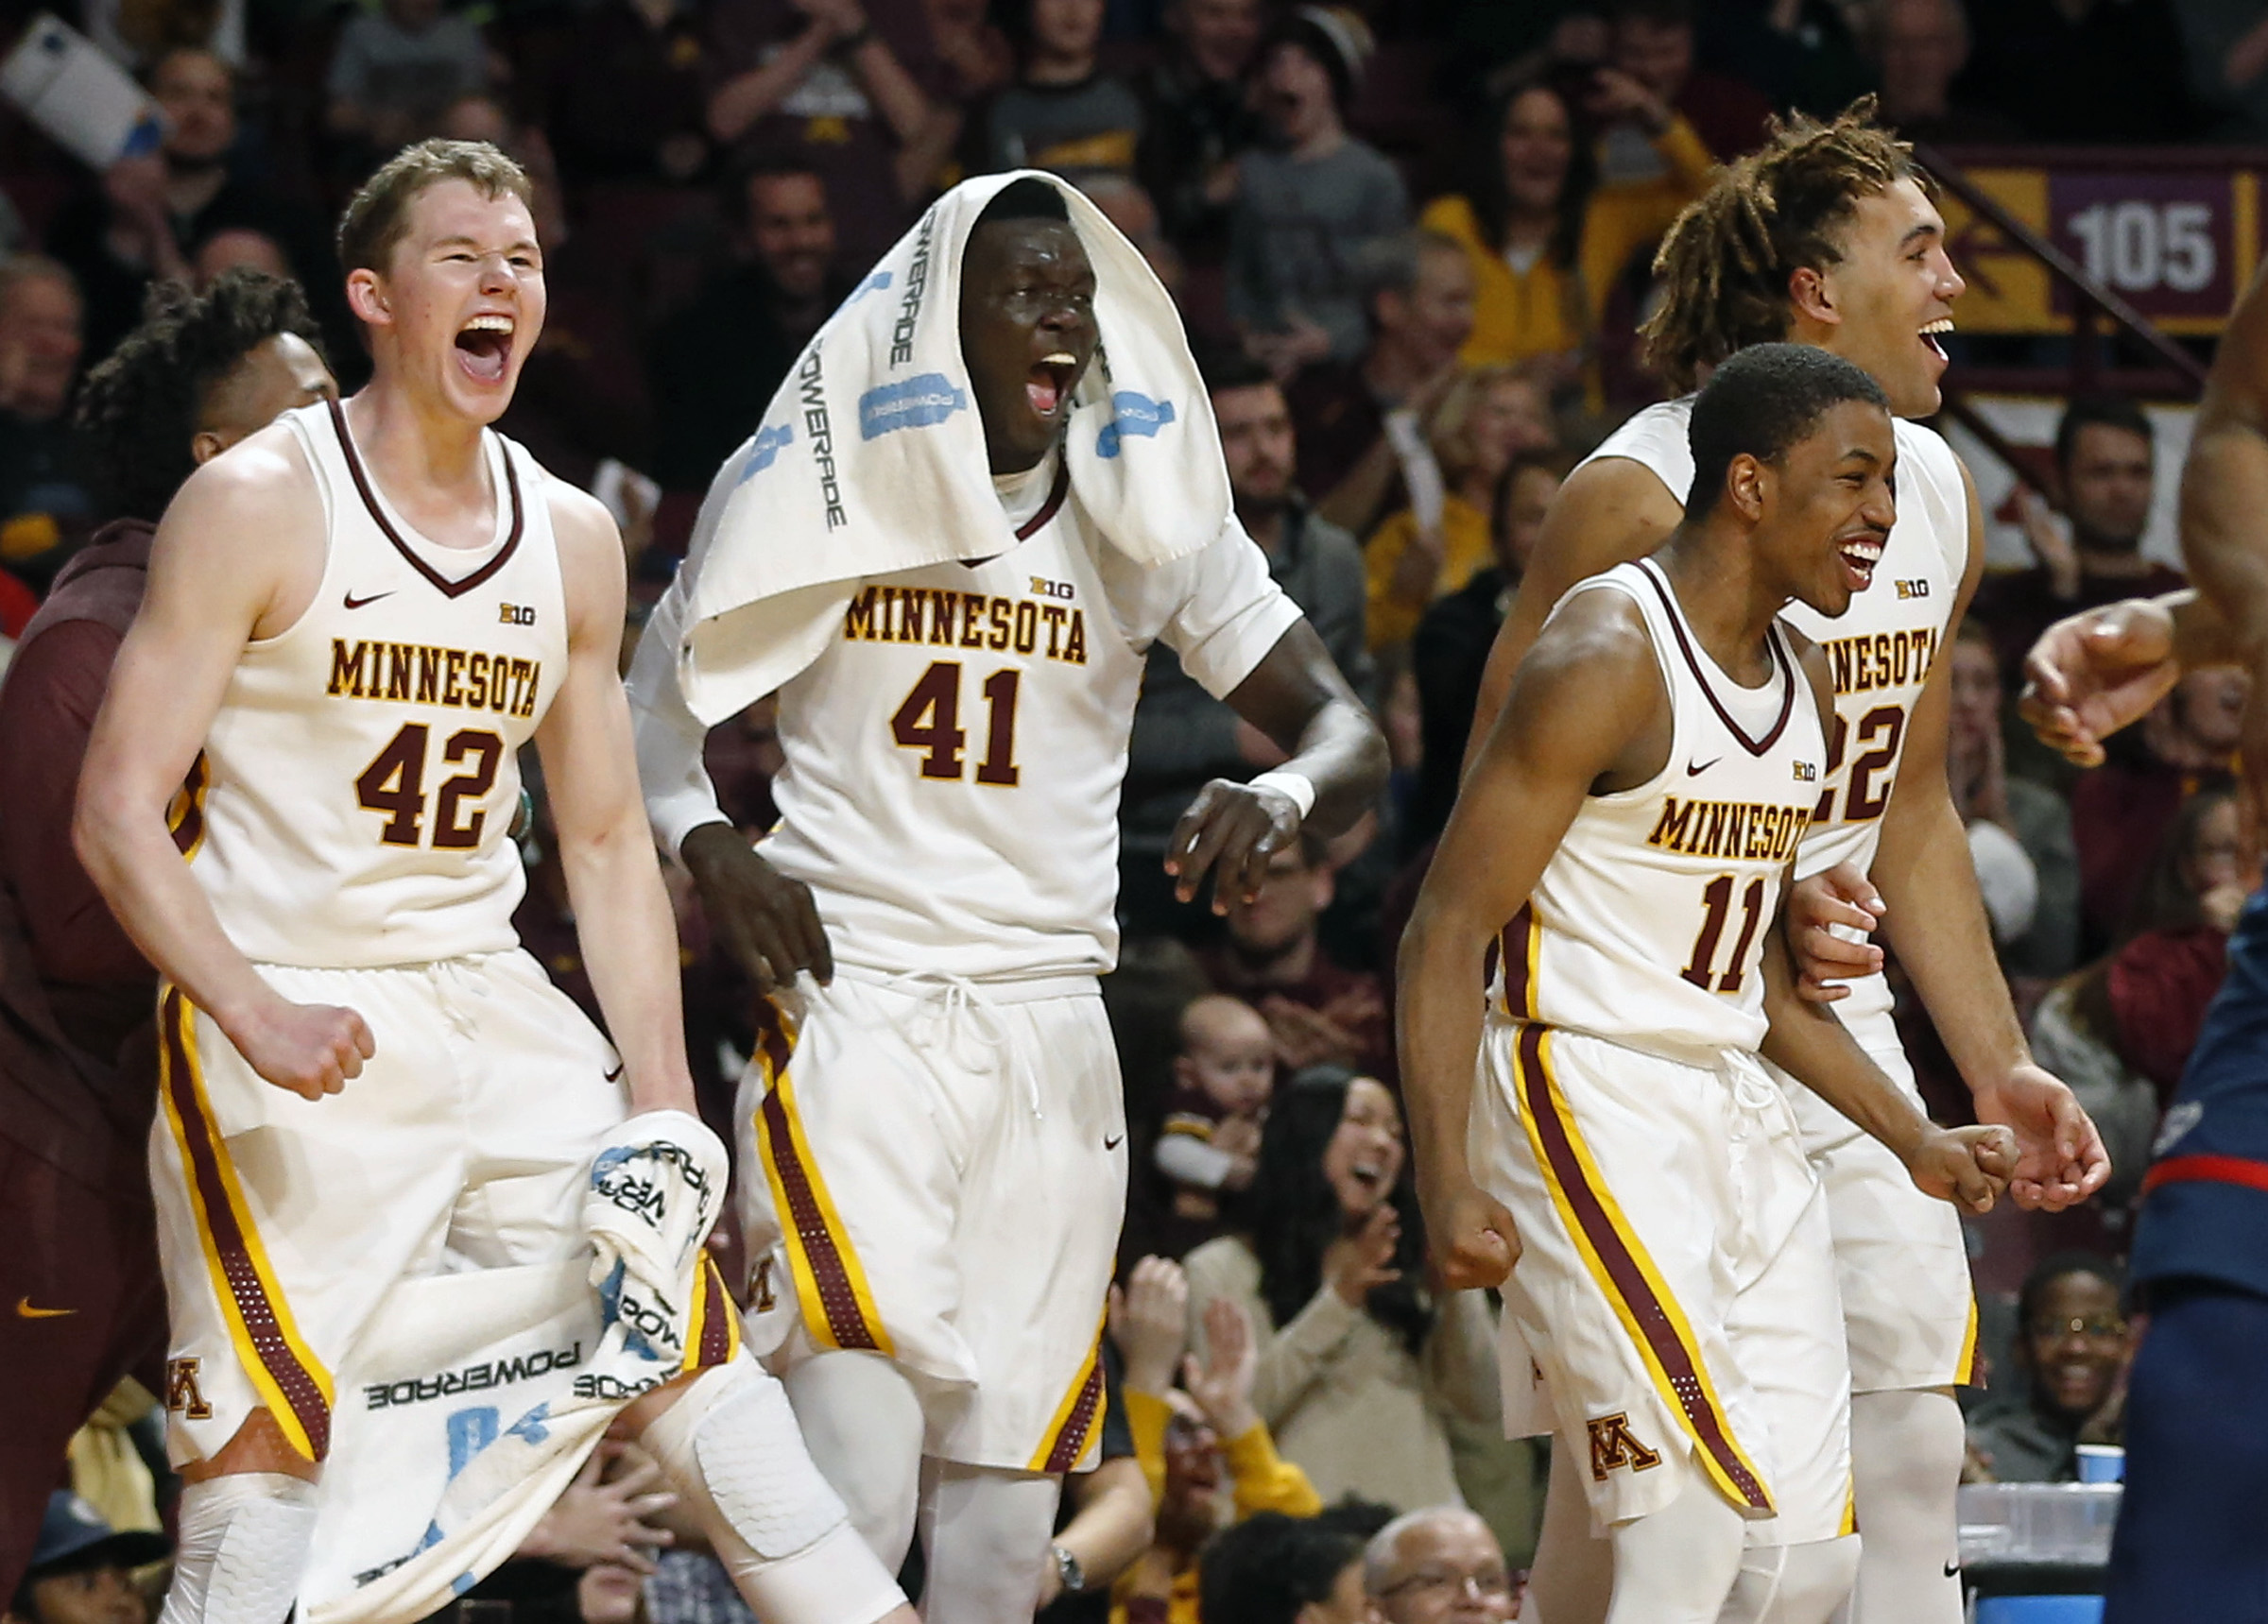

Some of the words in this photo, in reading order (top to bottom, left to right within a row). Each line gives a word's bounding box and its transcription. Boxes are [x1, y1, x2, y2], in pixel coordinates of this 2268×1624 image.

[890, 207, 937, 369] OWERADE
[2067, 201, 2217, 292] 105
[845, 585, 1089, 664] MINNESOTA
[326, 638, 541, 719] MINNESOTA
[888, 659, 1022, 788] 41
[353, 721, 506, 851] 42
[1647, 798, 1814, 862] MINNESOT
[1680, 873, 1766, 995] 11
[363, 1341, 581, 1410] POWERADE
[1587, 1411, 1662, 1481] M
